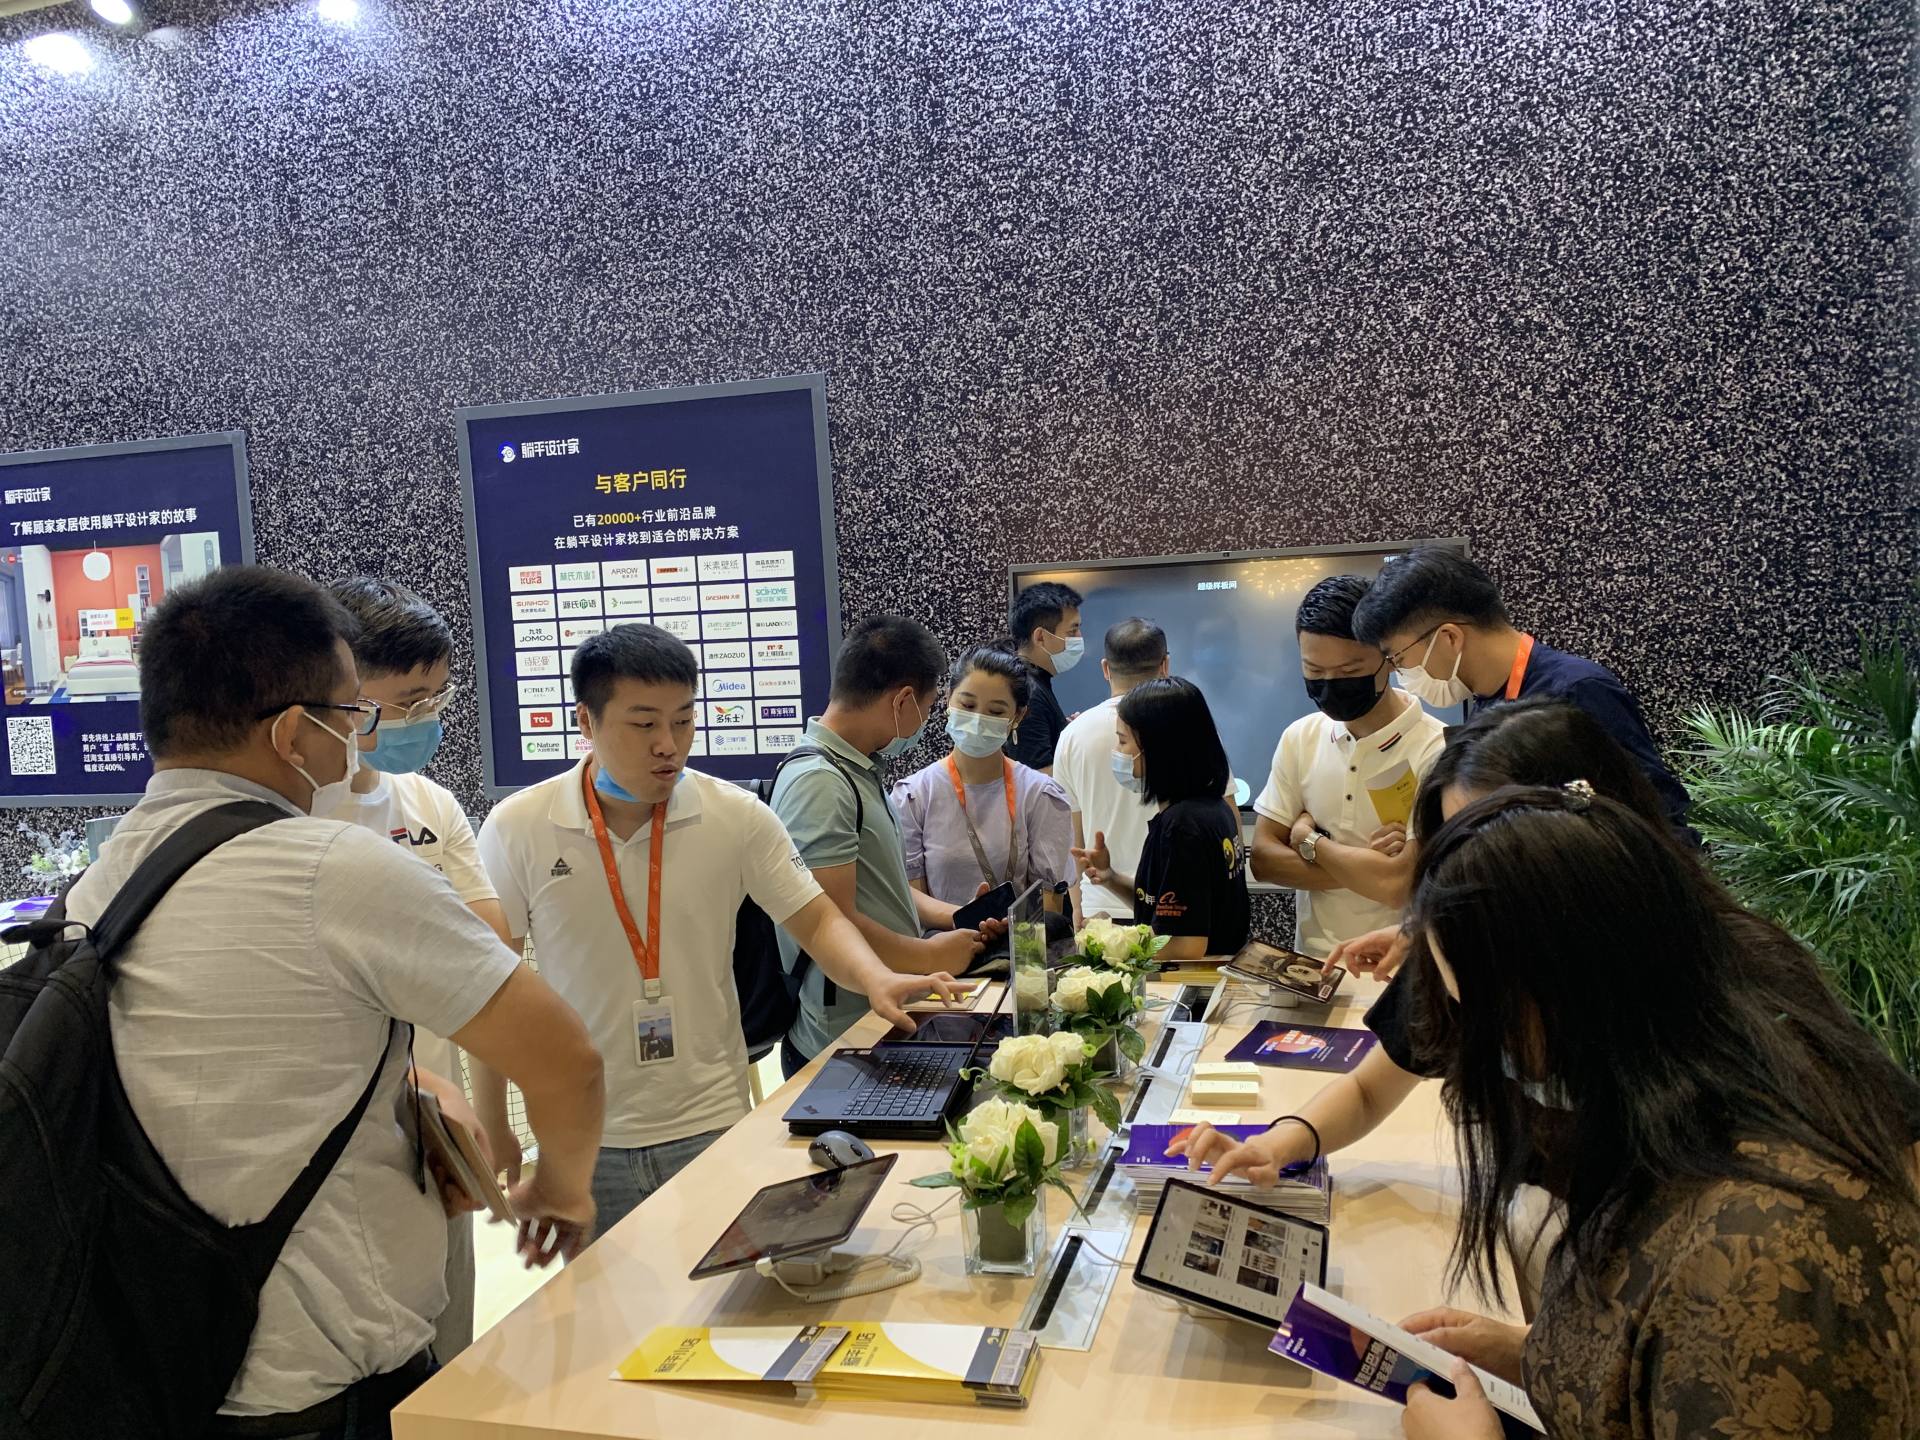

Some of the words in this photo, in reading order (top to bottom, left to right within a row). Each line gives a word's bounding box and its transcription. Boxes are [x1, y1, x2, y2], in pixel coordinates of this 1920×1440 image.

[520, 438, 580, 459] 躺平设计家
[595, 468, 687, 494] 与客户同行
[5, 486, 51, 504] 躺平设计家
[10, 508, 197, 536] 了解顾家家居使用躺平设计家的故事
[573, 505, 717, 528] 已有20000+行业前沿品牌
[554, 525, 740, 550] 在躺平设计家找到适合的解决方案
[611, 567, 638, 575] ARROW
[718, 682, 746, 691] Midea
[532, 716, 550, 724] TCL
[716, 714, 741, 724] 多乐士
